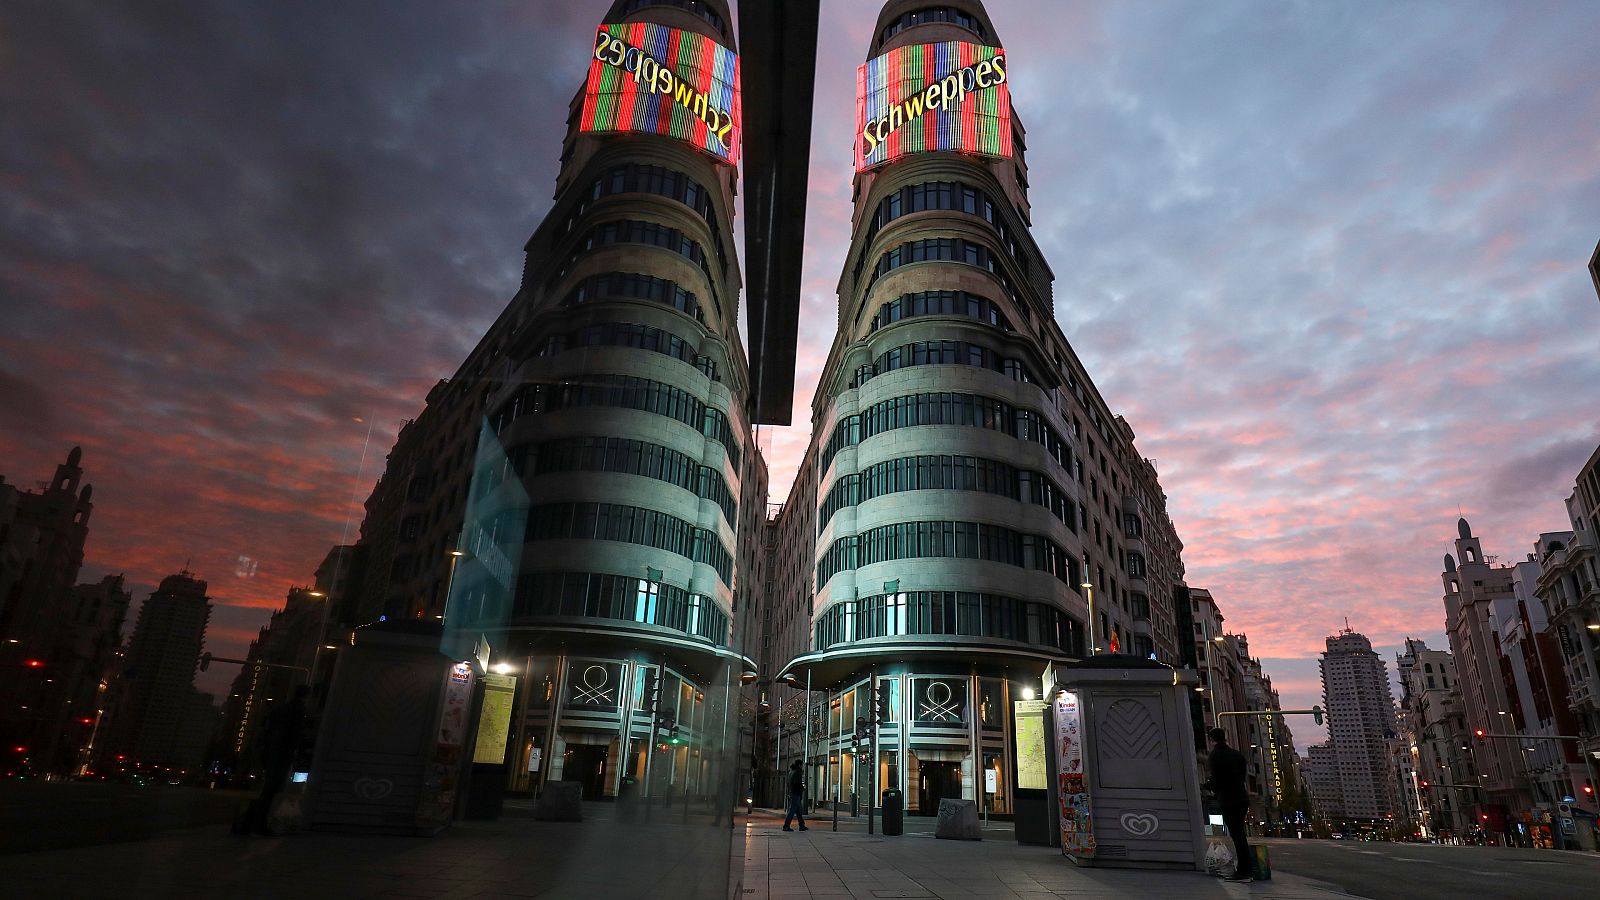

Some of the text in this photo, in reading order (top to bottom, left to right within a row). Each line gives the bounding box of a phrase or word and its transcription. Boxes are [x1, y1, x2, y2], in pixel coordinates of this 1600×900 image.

[863, 55, 1006, 158] Schweppes
[1265, 707, 1274, 739] HOTEL
[1562, 818, 1573, 828] P
